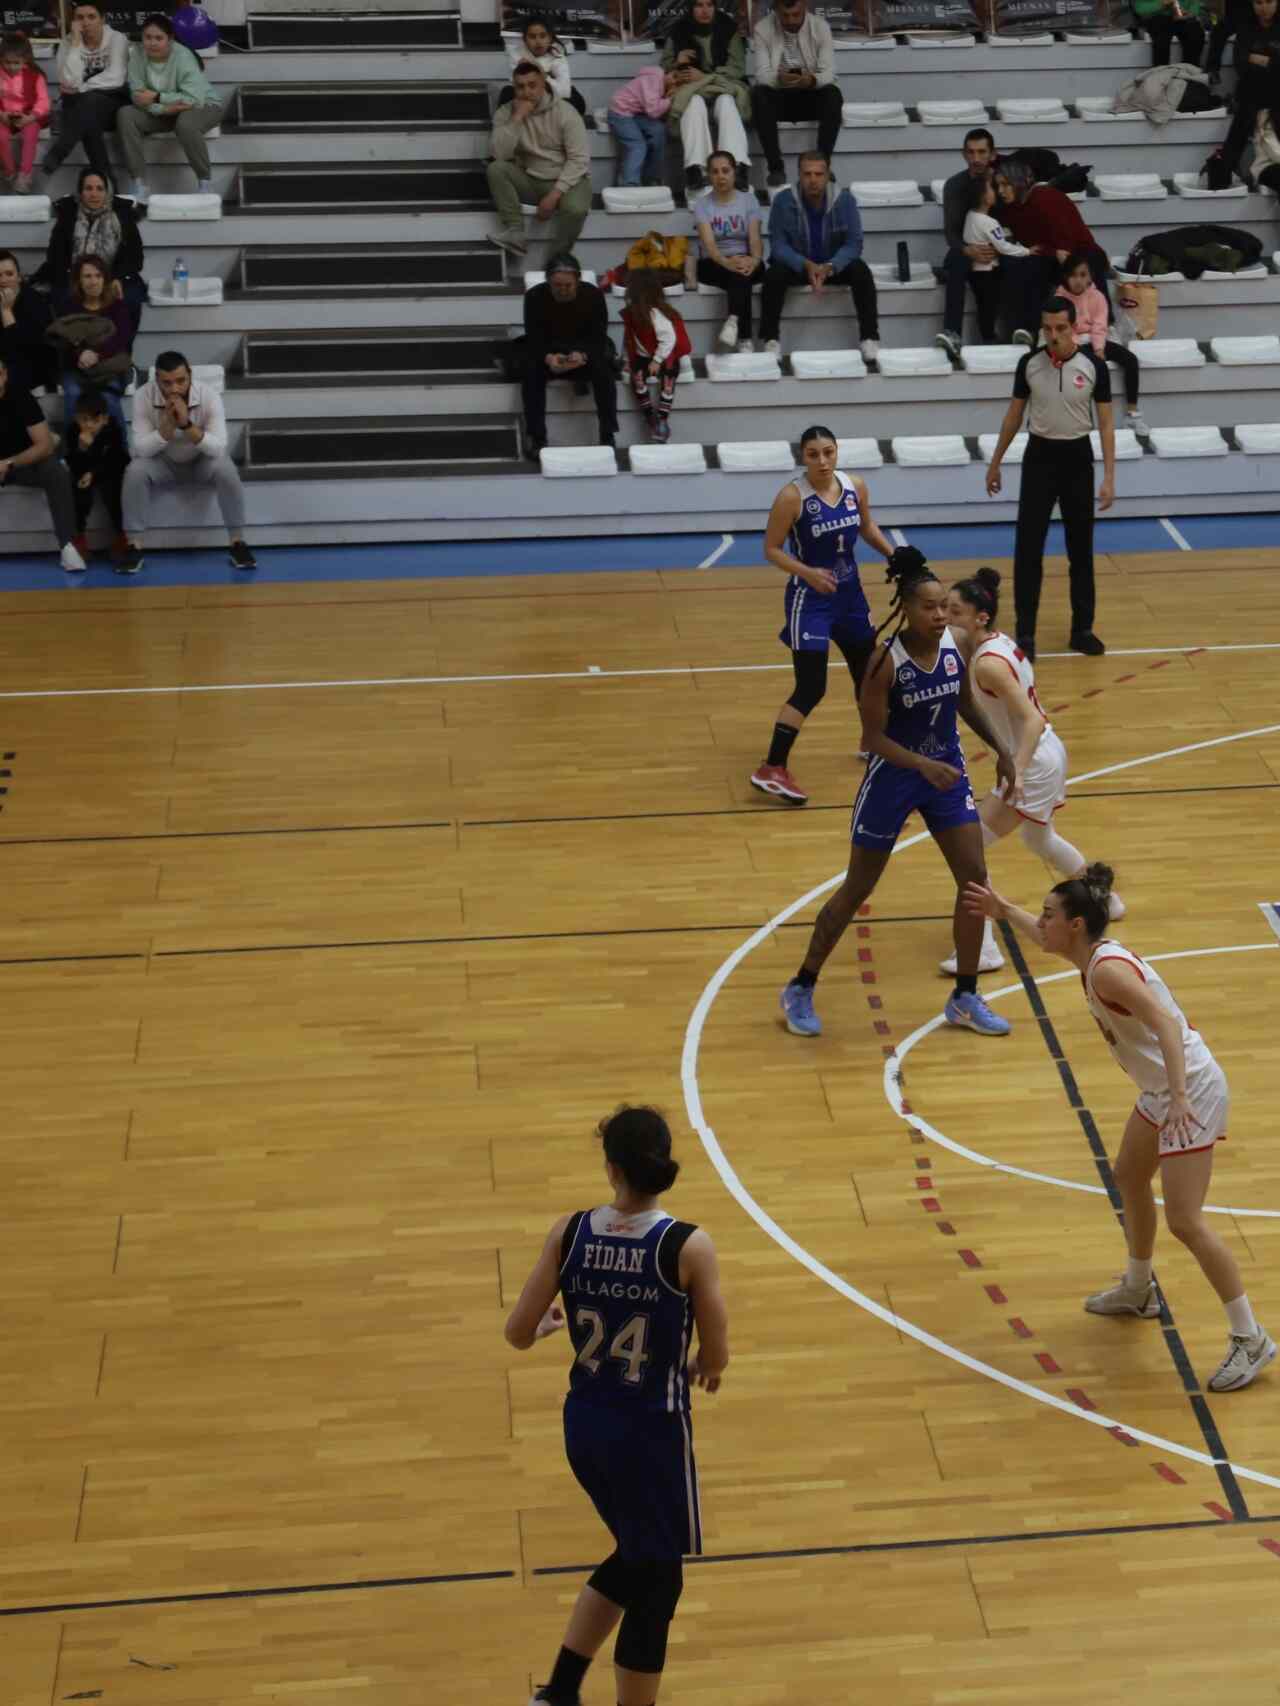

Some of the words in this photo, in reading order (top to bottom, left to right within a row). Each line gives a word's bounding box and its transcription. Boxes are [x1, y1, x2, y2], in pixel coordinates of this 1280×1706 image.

[836, 533, 846, 553] 1
[929, 703, 942, 726] 7
[582, 1240, 647, 1273] FİDAN
[575, 1304, 650, 1385] 24
